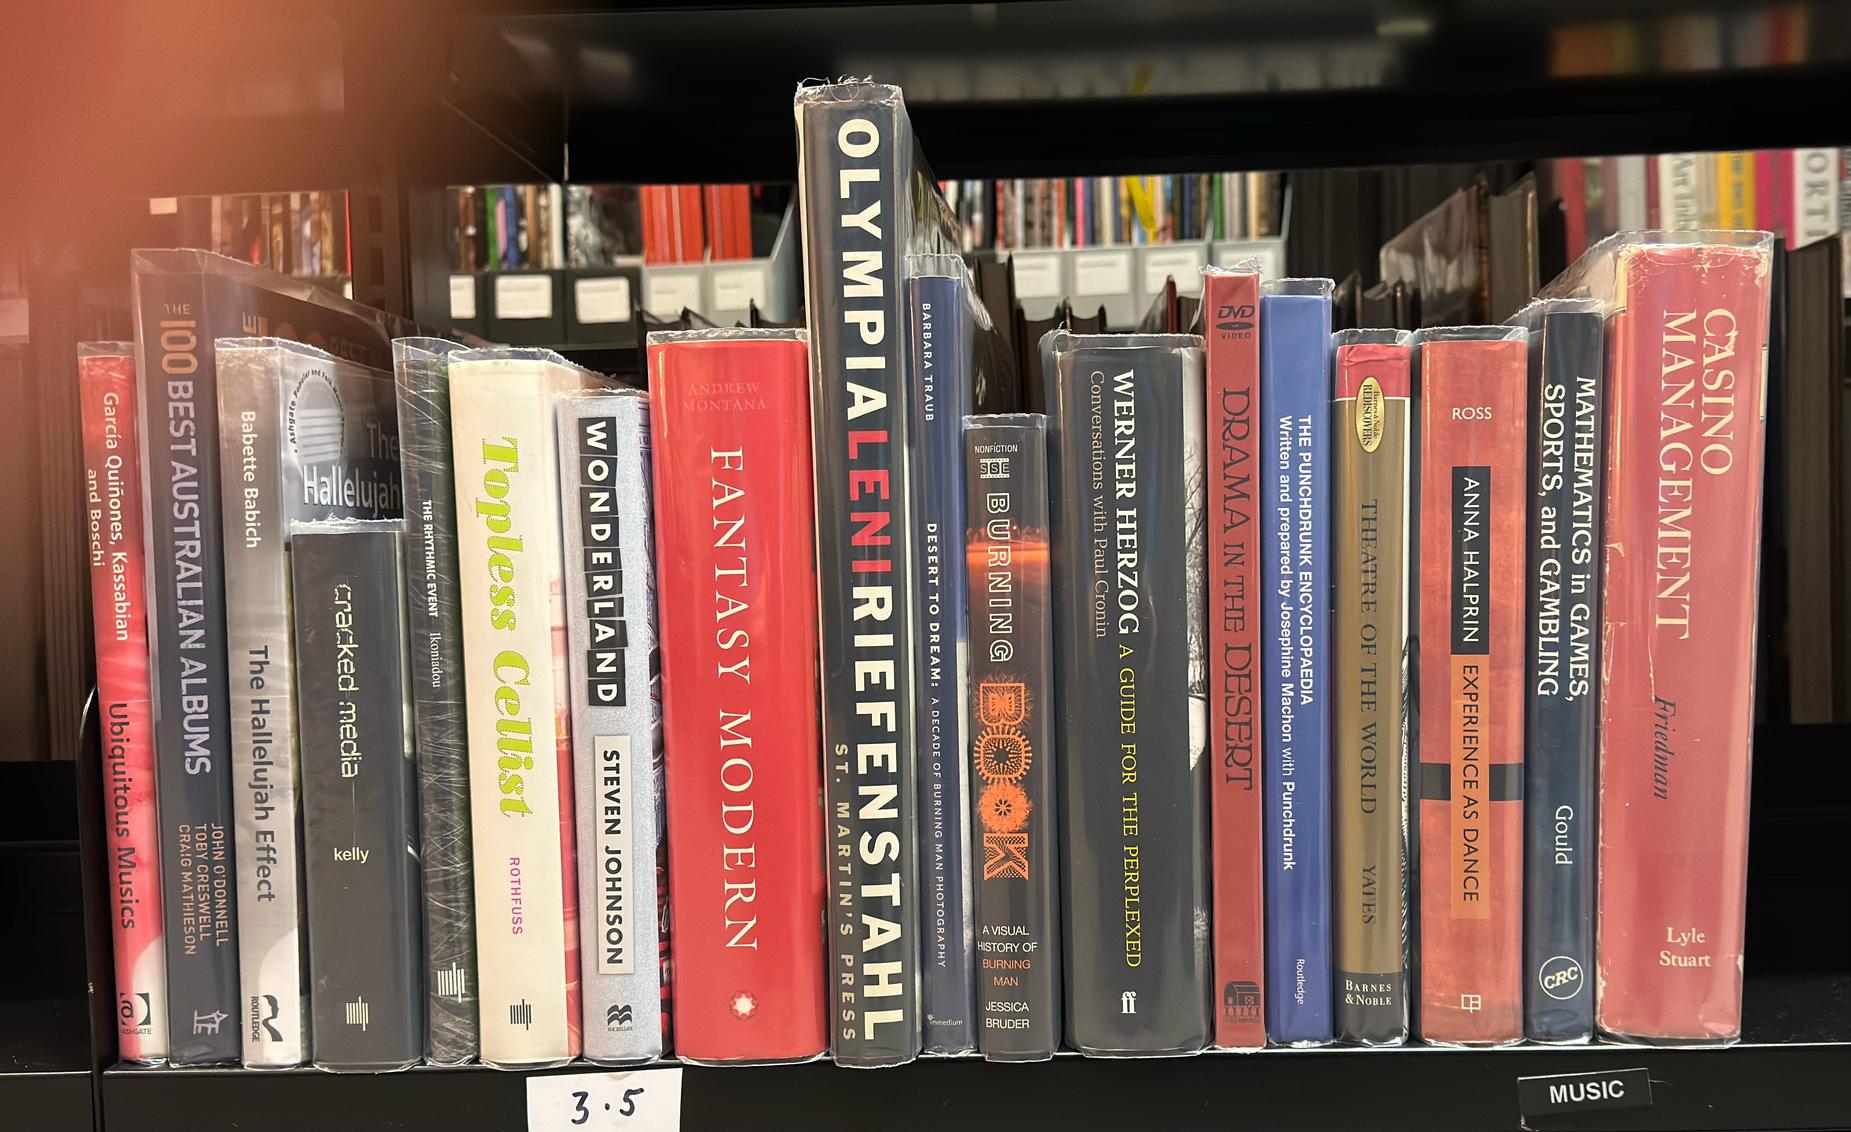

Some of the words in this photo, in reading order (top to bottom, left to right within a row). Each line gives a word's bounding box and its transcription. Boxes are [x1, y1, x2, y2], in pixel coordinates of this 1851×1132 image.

[164, 303, 191, 315] THE
[922, 303, 933, 370] BARBARA
[1217, 305, 1255, 319] DVD
[160, 320, 198, 375] 100
[168, 381, 196, 456] BEST
[683, 399, 768, 412] MONTANA
[688, 383, 761, 395] ANDREW
[924, 375, 934, 422] TRAUB
[1362, 384, 1373, 446] REDISCOVERS
[1452, 407, 1493, 420] ROSS
[1700, 307, 1737, 476] CASINO
[103, 392, 118, 450] García
[241, 411, 257, 481] Babette
[289, 401, 297, 444] Ashgate
[370, 422, 400, 461] The
[1090, 370, 1107, 490] Conversations
[1112, 369, 1137, 500] WERNER
[1278, 416, 1292, 469] Written
[1298, 415, 1312, 447] THE
[1537, 383, 1566, 498] SPORTS,
[88, 469, 100, 502] and
[1220, 387, 1251, 533] DRAMA
[1279, 476, 1291, 502] and
[1571, 376, 1597, 565] MATHEMATICS
[1655, 309, 1697, 640] MANAGEMENT
[105, 455, 122, 547] Quiñones,
[243, 488, 259, 549] Babich
[303, 465, 400, 518] Hallelujah
[423, 500, 432, 521] THE
[1093, 495, 1108, 534] with
[1298, 450, 1313, 566] PUNCHDRUNK
[1463, 476, 1480, 542] ANNA
[90, 508, 105, 567] Boschi
[172, 461, 206, 651] AUSTRALIAN
[424, 524, 436, 581] RHYTHMIC
[476, 436, 523, 631] Topless
[927, 523, 939, 586] DESERT
[1093, 538, 1109, 576] Paul
[1223, 543, 1246, 567] IN
[1277, 508, 1292, 576] prepared
[1360, 499, 1378, 613] THEATRE
[1541, 506, 1562, 550] and
[585, 421, 618, 702] WONDERLAND
[710, 446, 751, 685] FANTASY
[987, 493, 1013, 662] BURNING
[1116, 508, 1140, 635] HERZOG
[1277, 580, 1292, 597] by
[1571, 573, 1592, 594] in
[111, 551, 129, 641] Kassabian
[427, 584, 438, 618] EVENT
[929, 593, 940, 617] TO
[1093, 580, 1109, 638] Cronin
[1223, 575, 1246, 632] THE
[1463, 550, 1480, 643] HALPRIN
[335, 584, 359, 693] cracked
[930, 623, 941, 687] DREAM:
[1119, 644, 1135, 659] A
[1278, 600, 1293, 678] Josephine
[1299, 571, 1313, 705] ENCYCLOPAEDIA
[1360, 624, 1377, 656] OF
[1537, 559, 1561, 696] GAMBLING
[1566, 603, 1591, 702] GAMES,
[248, 645, 268, 690] The
[430, 632, 441, 688] Ikoniadou
[1360, 664, 1377, 713] THE
[180, 657, 211, 775] ALBUMS
[931, 698, 937, 706] A
[1119, 667, 1137, 735] GUIDE
[1223, 643, 1253, 791] DESERT
[1280, 683, 1293, 743] Machon
[1463, 664, 1480, 790] EXPERIENCE
[249, 697, 276, 821] Hallelujah
[339, 702, 363, 778] media
[492, 650, 534, 818] Cellist
[835, 744, 848, 783] ST.
[932, 710, 940, 759] DECADE
[1280, 747, 1293, 777] with
[1653, 695, 1677, 800] Friedman
[108, 703, 130, 838] Ubiquitous
[603, 749, 622, 835] STEVEN
[933, 762, 942, 778] OF
[974, 680, 1034, 882] BOOK
[1121, 743, 1137, 785] FOR
[1360, 720, 1377, 815] WORLD
[719, 709, 758, 951] MODERN
[934, 784, 943, 838] BURNING
[1122, 793, 1139, 836] THE
[1281, 781, 1296, 871] Punchdrunk
[1463, 795, 1480, 820] AS
[1555, 805, 1574, 865] Gould
[178, 824, 191, 867] CRAIG
[195, 823, 208, 861] TOBY
[211, 823, 224, 860] JOHN
[254, 830, 277, 902] Effect
[334, 847, 369, 865] kelly
[836, 803, 853, 936] MARTIN'S
[935, 843, 943, 870] MAN
[1463, 828, 1480, 902] DANCE
[116, 846, 136, 929] Musics
[181, 871, 196, 955] MATHIESON
[196, 864, 212, 941] CRESWELL
[214, 863, 229, 946] O'DONNELL
[509, 857, 523, 935] ROTHFUSS
[604, 846, 623, 965] JOHNSON
[1123, 845, 1142, 968] PERPLEXED
[1361, 865, 1377, 925] YATES
[935, 876, 946, 967] PHOTOGRAPHY
[978, 941, 1021, 953] HISTORY
[1023, 941, 1037, 953] OF
[983, 926, 990, 935] A
[991, 925, 1030, 936] VISUAL
[1666, 928, 1706, 945] Lyle
[983, 958, 1031, 970] BURNING
[994, 976, 1019, 987] MAN
[1295, 958, 1304, 1006] Routledge
[1345, 980, 1392, 992] BARNES
[1544, 966, 1578, 989] CRC
[1659, 951, 1711, 968] Stuart
[251, 996, 260, 1042] ROUTLEDGE
[840, 954, 856, 1040] PRESS
[985, 1002, 1030, 1012] JESSICA
[985, 1018, 1030, 1029] BRUDER
[1121, 991, 1137, 1014] ff
[1345, 994, 1354, 1005] &
[1549, 1080, 1625, 1105] MUSIC
